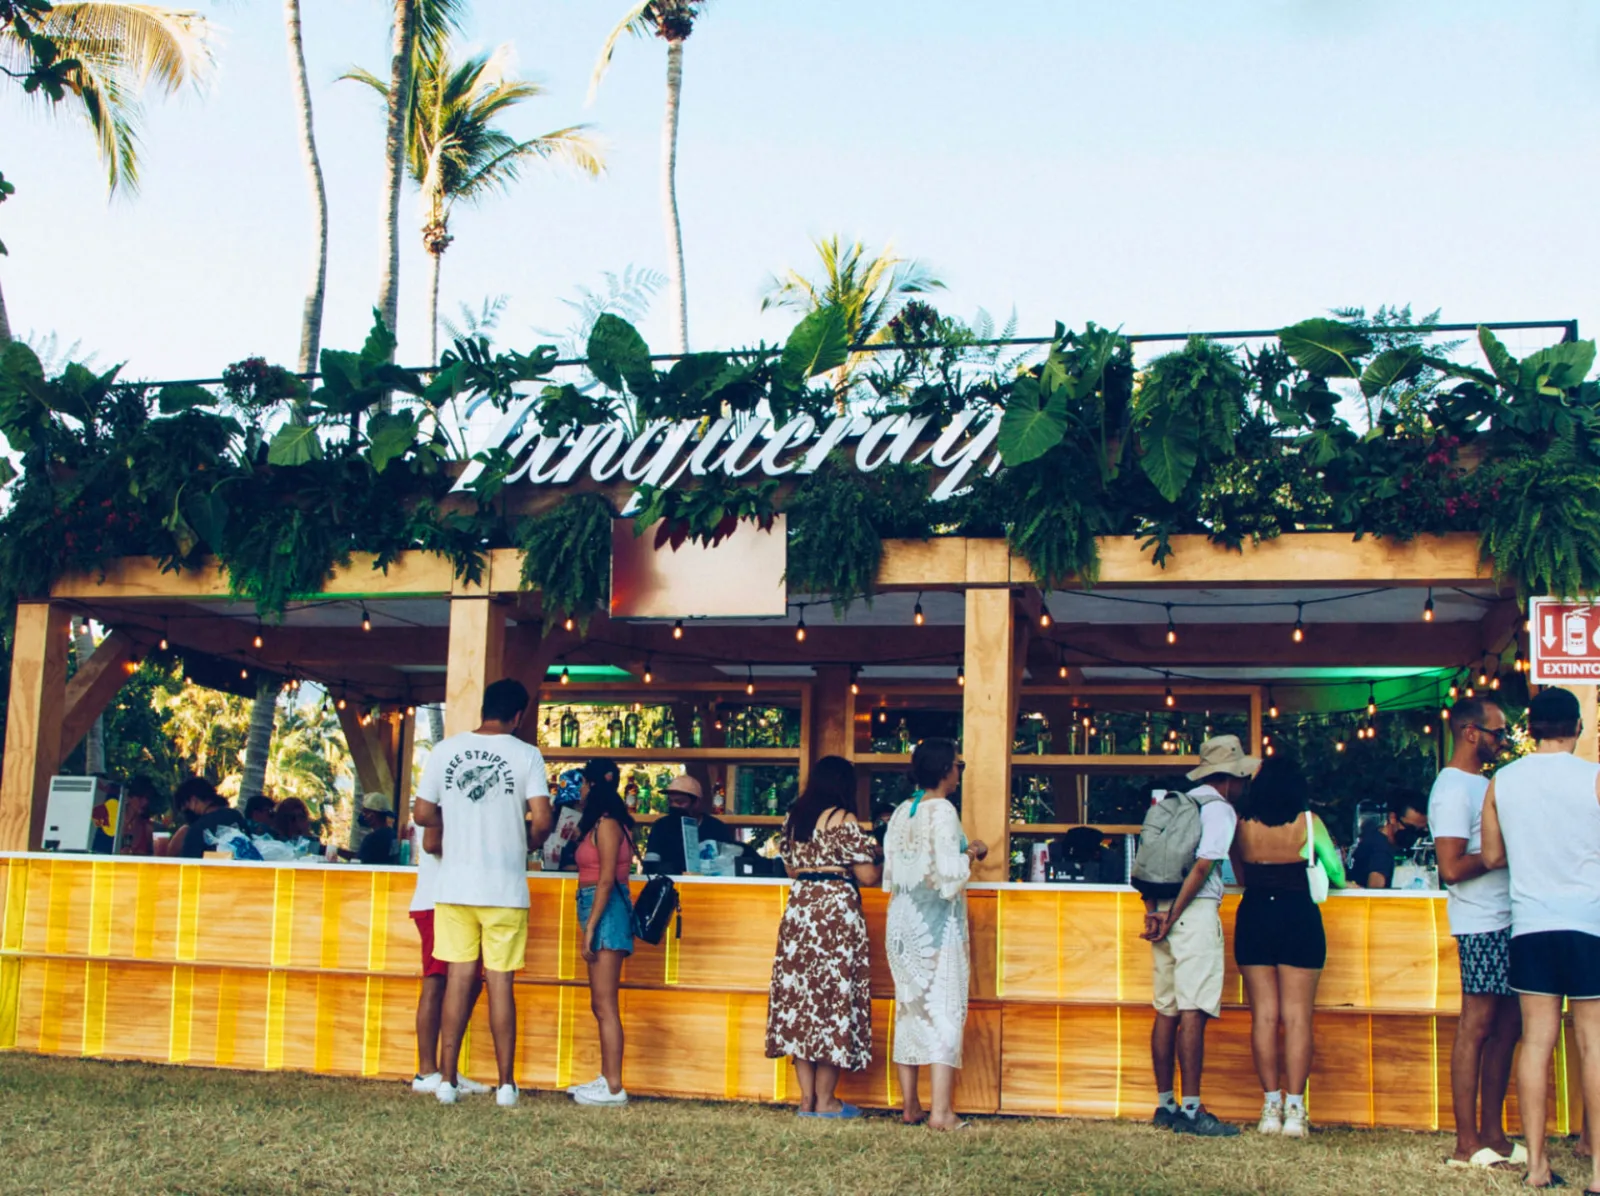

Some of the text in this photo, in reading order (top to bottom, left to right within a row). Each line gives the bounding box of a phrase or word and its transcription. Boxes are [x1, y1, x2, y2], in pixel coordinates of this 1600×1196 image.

[444, 750, 515, 795] THREE STRIPE LIFE
